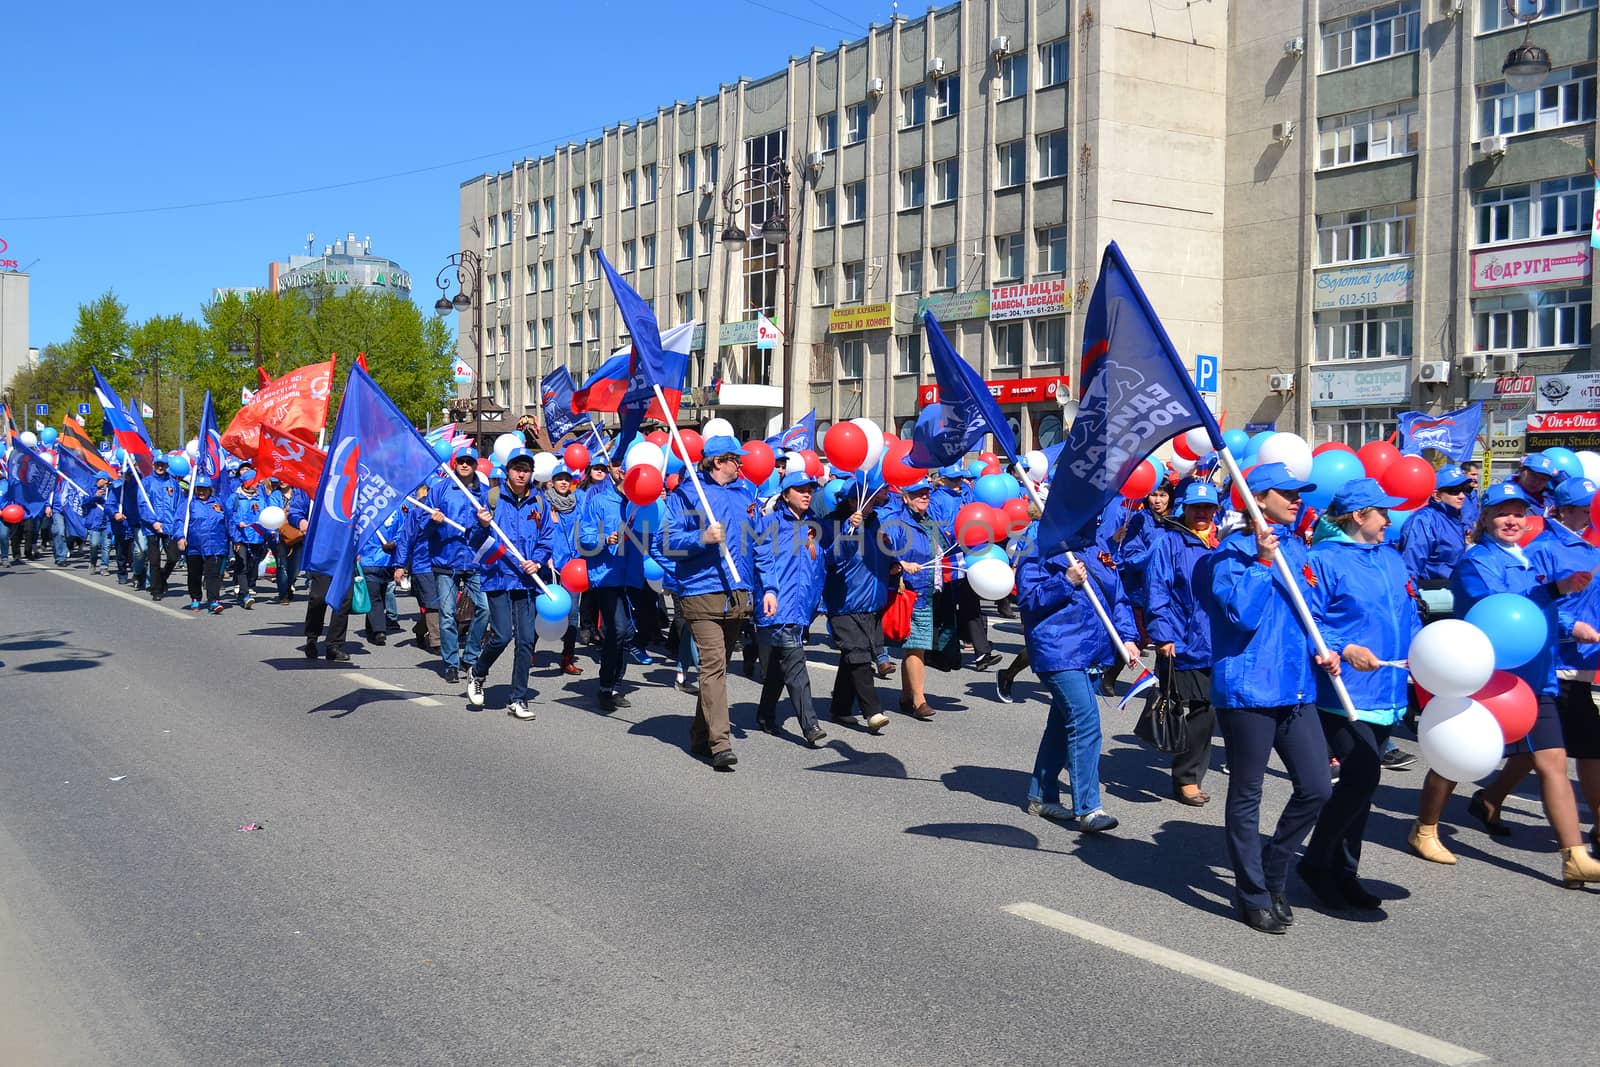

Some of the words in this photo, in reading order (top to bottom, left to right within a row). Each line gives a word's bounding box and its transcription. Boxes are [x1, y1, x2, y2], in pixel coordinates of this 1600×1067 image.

[991, 279, 1065, 300] ТЕПЛИЦЫ
[991, 298, 1025, 311] НАВЕСЫ,
[1026, 292, 1065, 306] БЕСЕДКИ
[1339, 292, 1377, 306] 612-513
[830, 320, 853, 331] БУКЕТЫ
[855, 319, 863, 329] ИЗ
[866, 316, 889, 328] КОНФЕТ
[759, 327, 767, 339] 9
[1201, 358, 1213, 388] P
